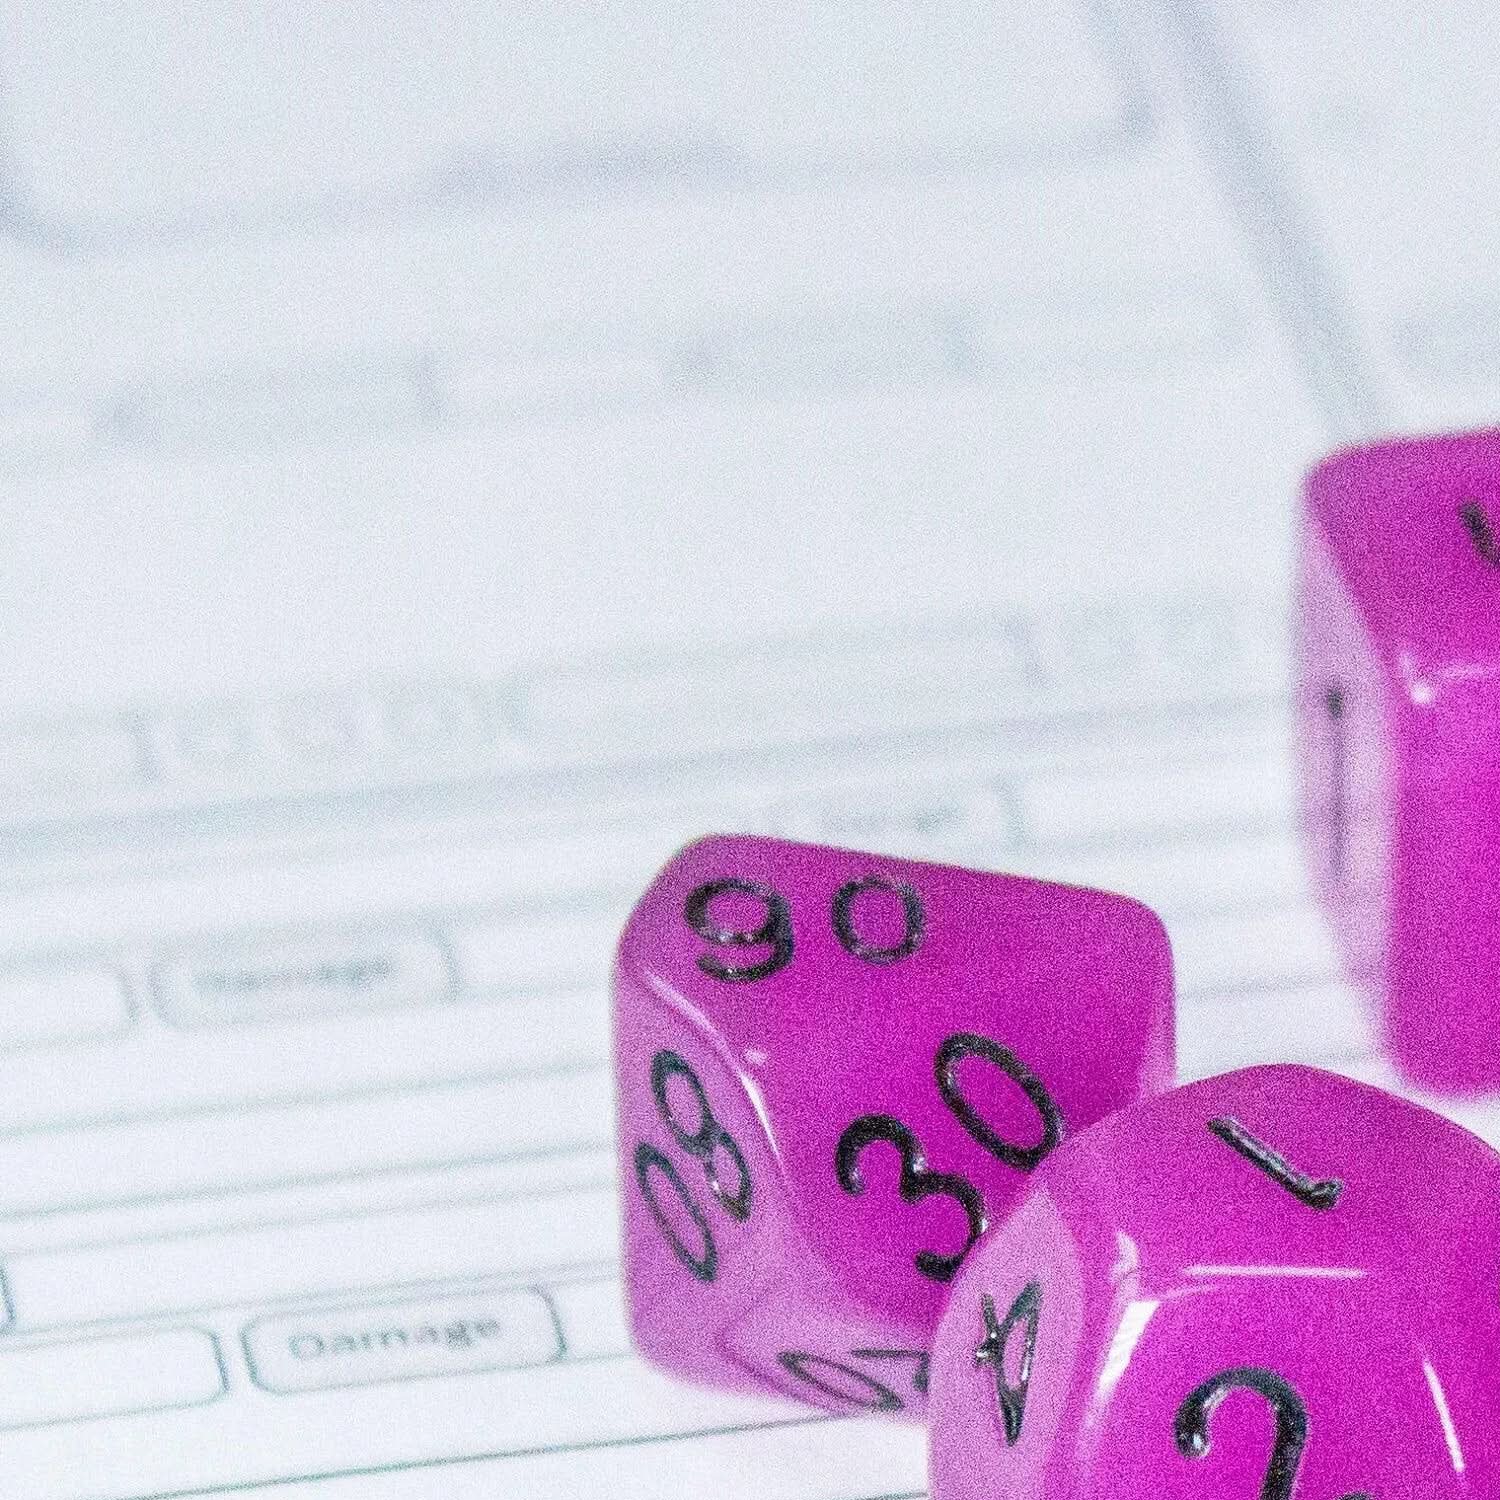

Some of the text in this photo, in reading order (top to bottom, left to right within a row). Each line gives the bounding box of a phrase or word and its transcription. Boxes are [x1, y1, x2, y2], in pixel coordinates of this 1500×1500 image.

[683, 876, 927, 984] 90
[633, 1049, 754, 1285] 80
[834, 1032, 1064, 1285] 30
[1207, 1115, 1344, 1210] 1
[974, 1281, 1045, 1447] 4
